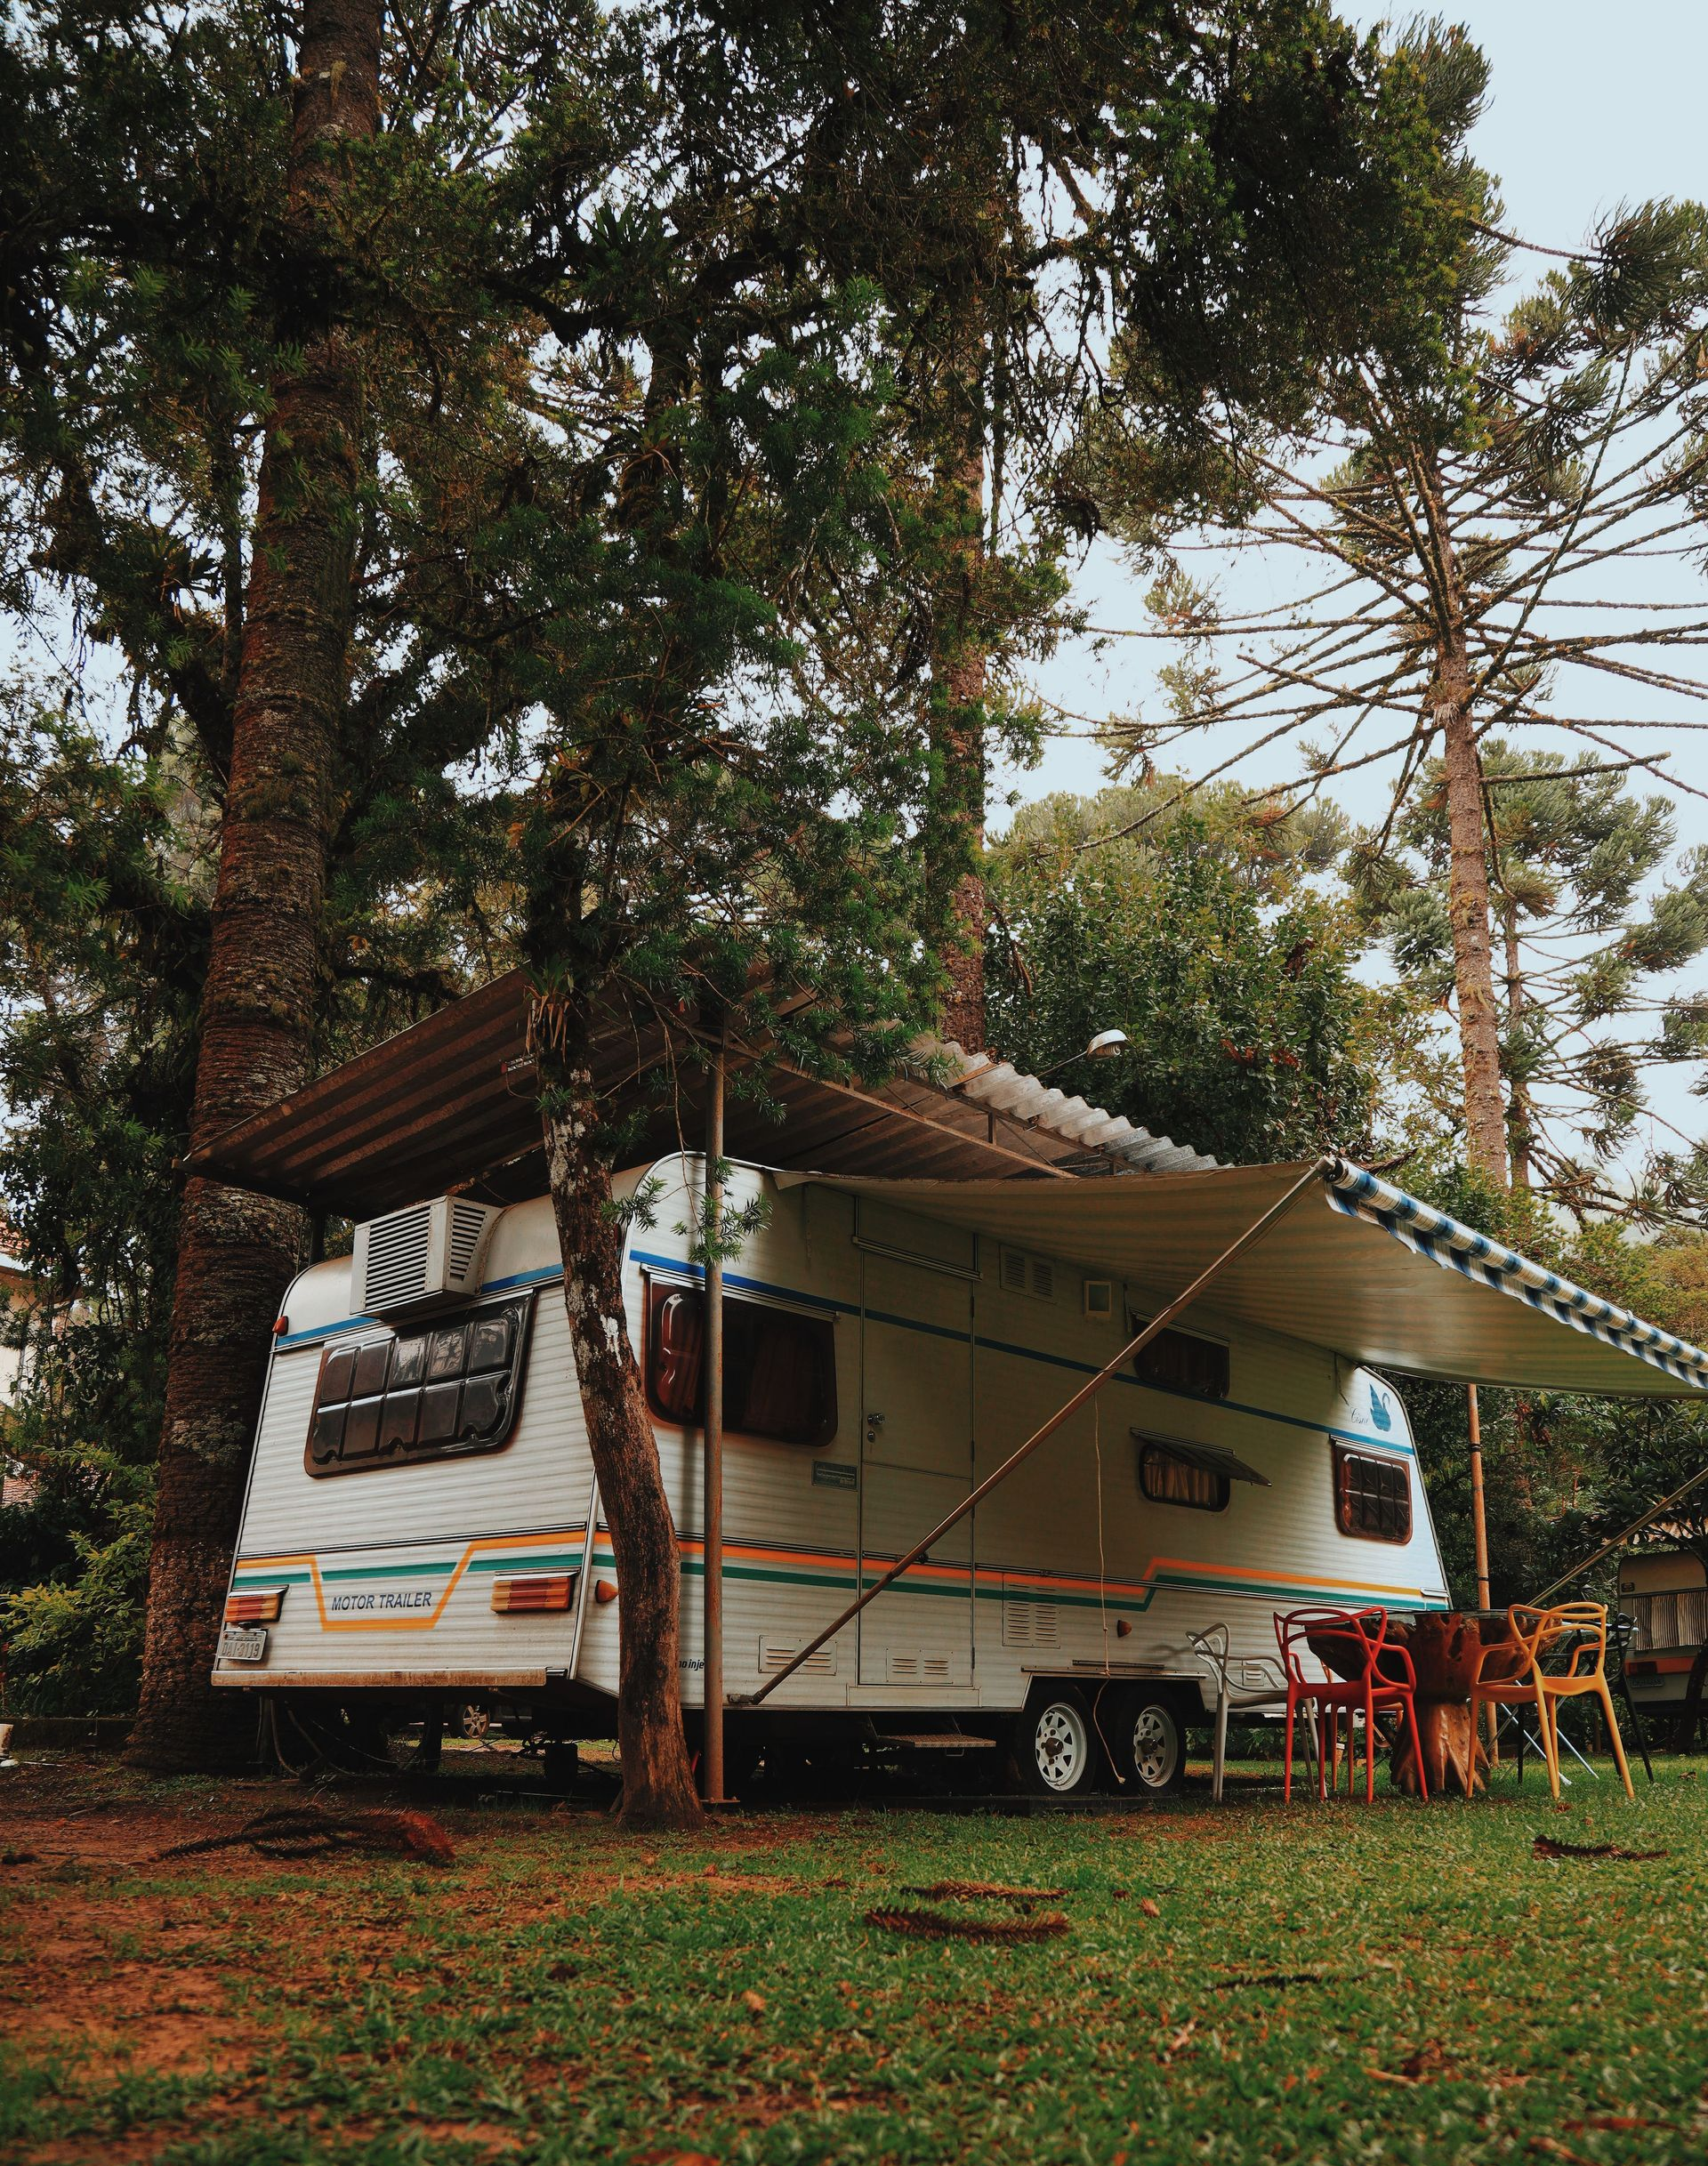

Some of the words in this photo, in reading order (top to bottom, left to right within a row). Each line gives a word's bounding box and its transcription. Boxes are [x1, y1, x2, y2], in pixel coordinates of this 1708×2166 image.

[332, 1594, 375, 1611] MOTOR
[379, 1591, 432, 1609] TRAILER
[689, 1658, 705, 1671] inje
